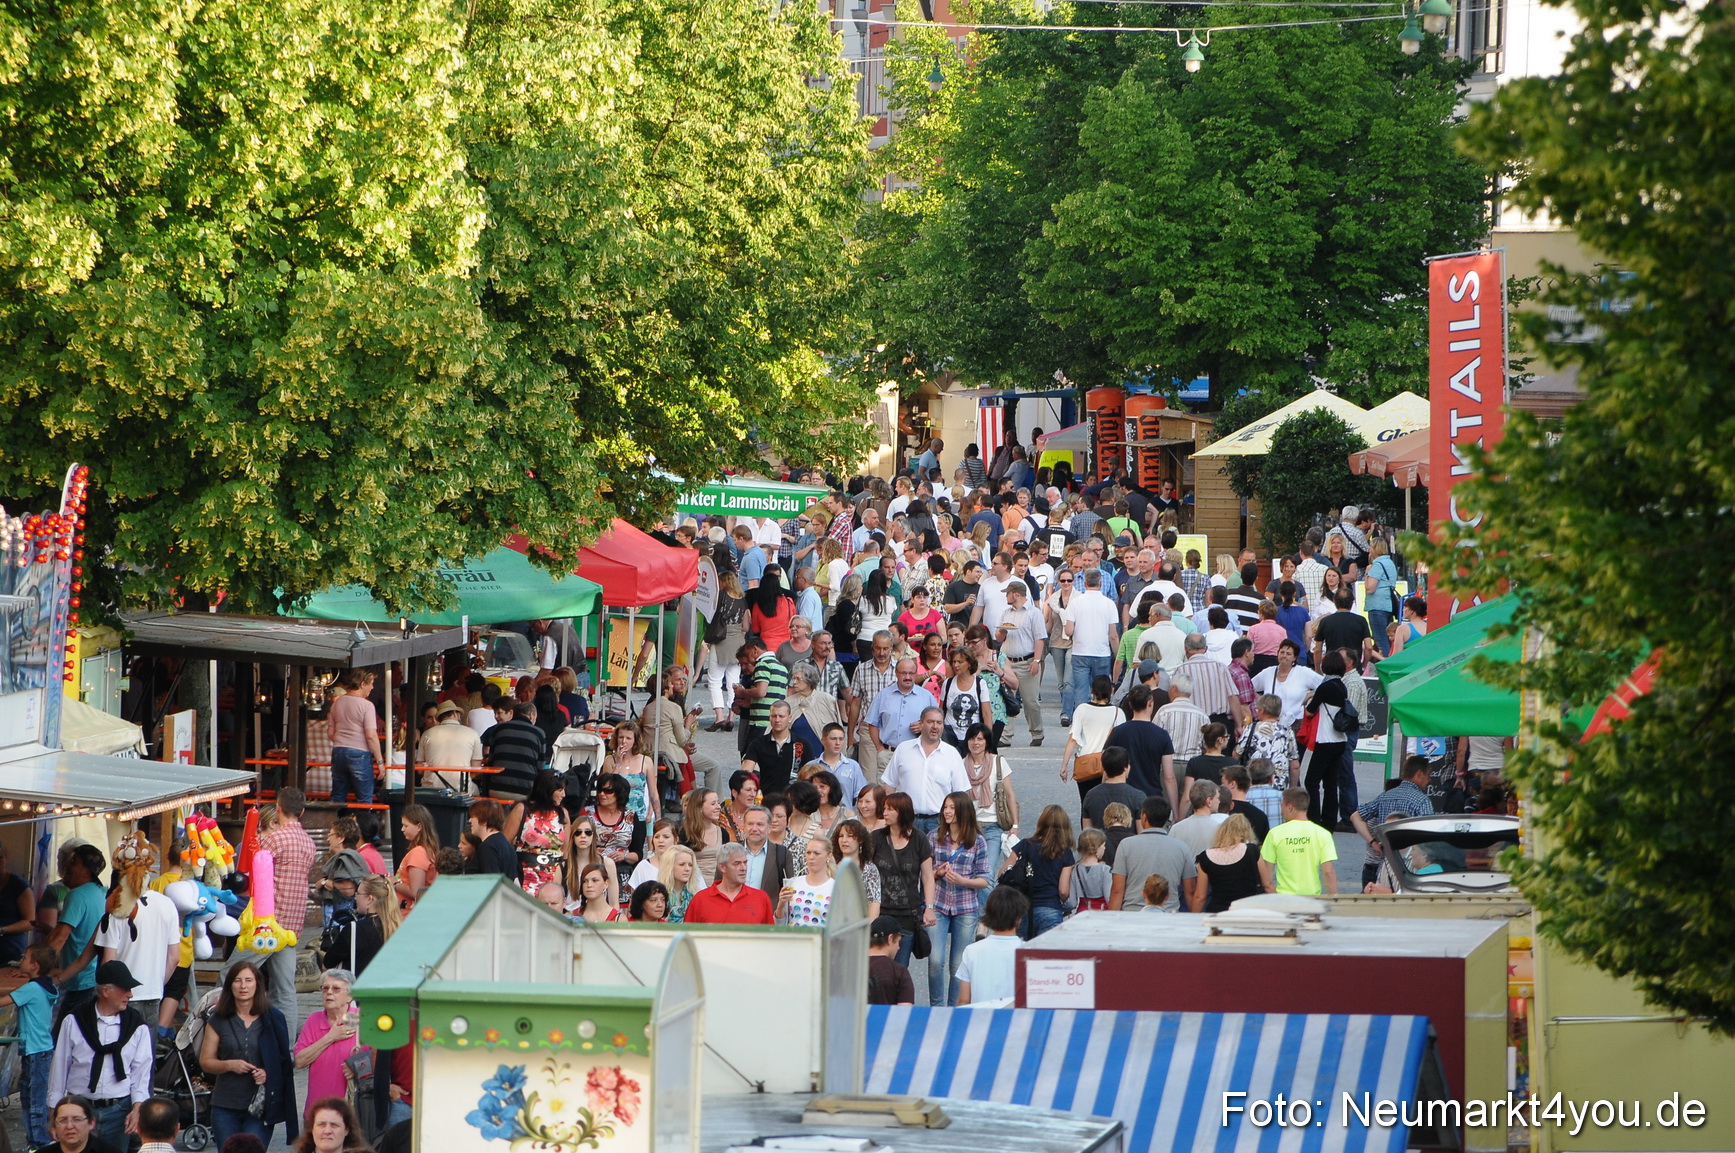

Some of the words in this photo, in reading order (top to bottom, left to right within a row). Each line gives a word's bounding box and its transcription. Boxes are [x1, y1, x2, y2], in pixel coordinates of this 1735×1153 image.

[720, 491, 799, 512] Lammsbräu
[435, 569, 496, 583] bräu
[1426, 784, 1446, 797] Bier
[1285, 836, 1311, 846] TADYCH
[1066, 973, 1084, 986] 80
